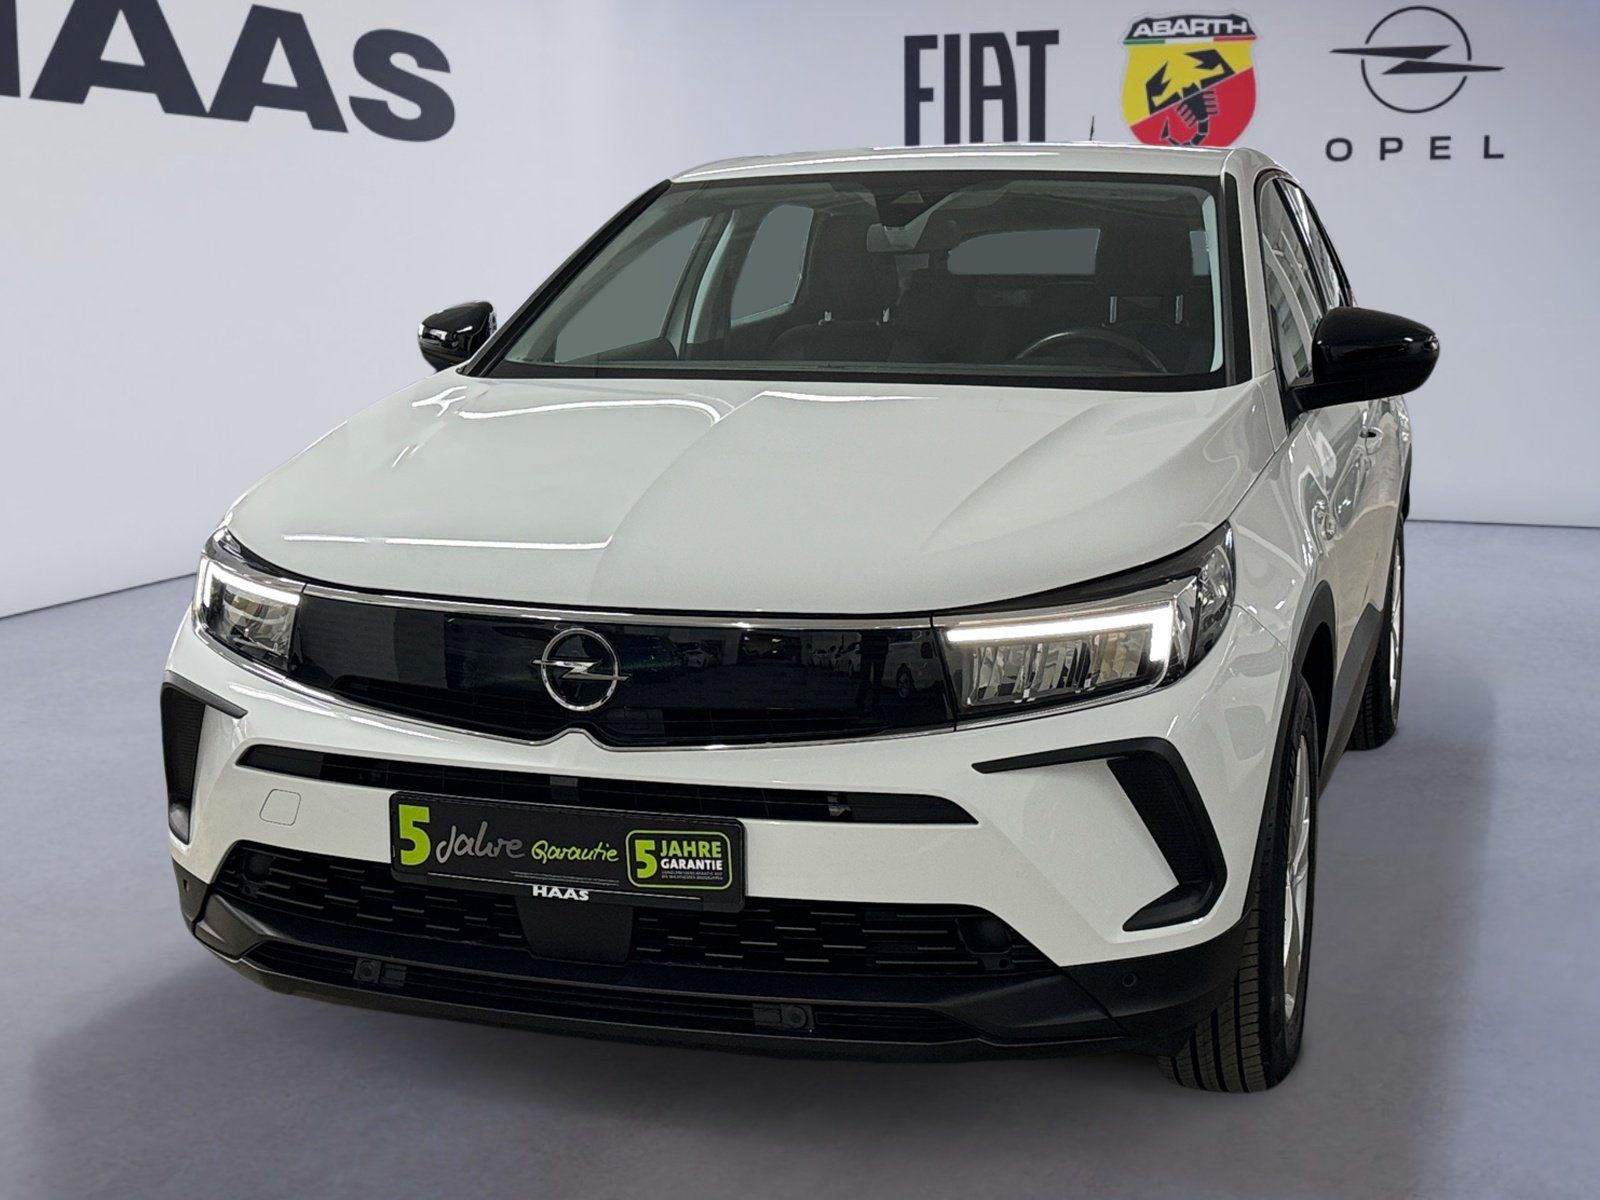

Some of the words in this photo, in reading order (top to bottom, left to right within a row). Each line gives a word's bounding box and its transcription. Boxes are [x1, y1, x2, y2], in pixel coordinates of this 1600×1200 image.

[1132, 18, 1248, 37] ABARTH
[0, 0, 455, 142] AAS
[904, 30, 1060, 144] FIAT
[1325, 135, 1505, 162] OPEL
[398, 804, 431, 866] 5
[435, 820, 526, 864] Jahre
[531, 840, 619, 864] Garantie
[635, 839, 658, 879] 5
[660, 840, 722, 858] JAHRE
[660, 858, 723, 871] GARANTIE
[532, 884, 590, 901] HAAS
